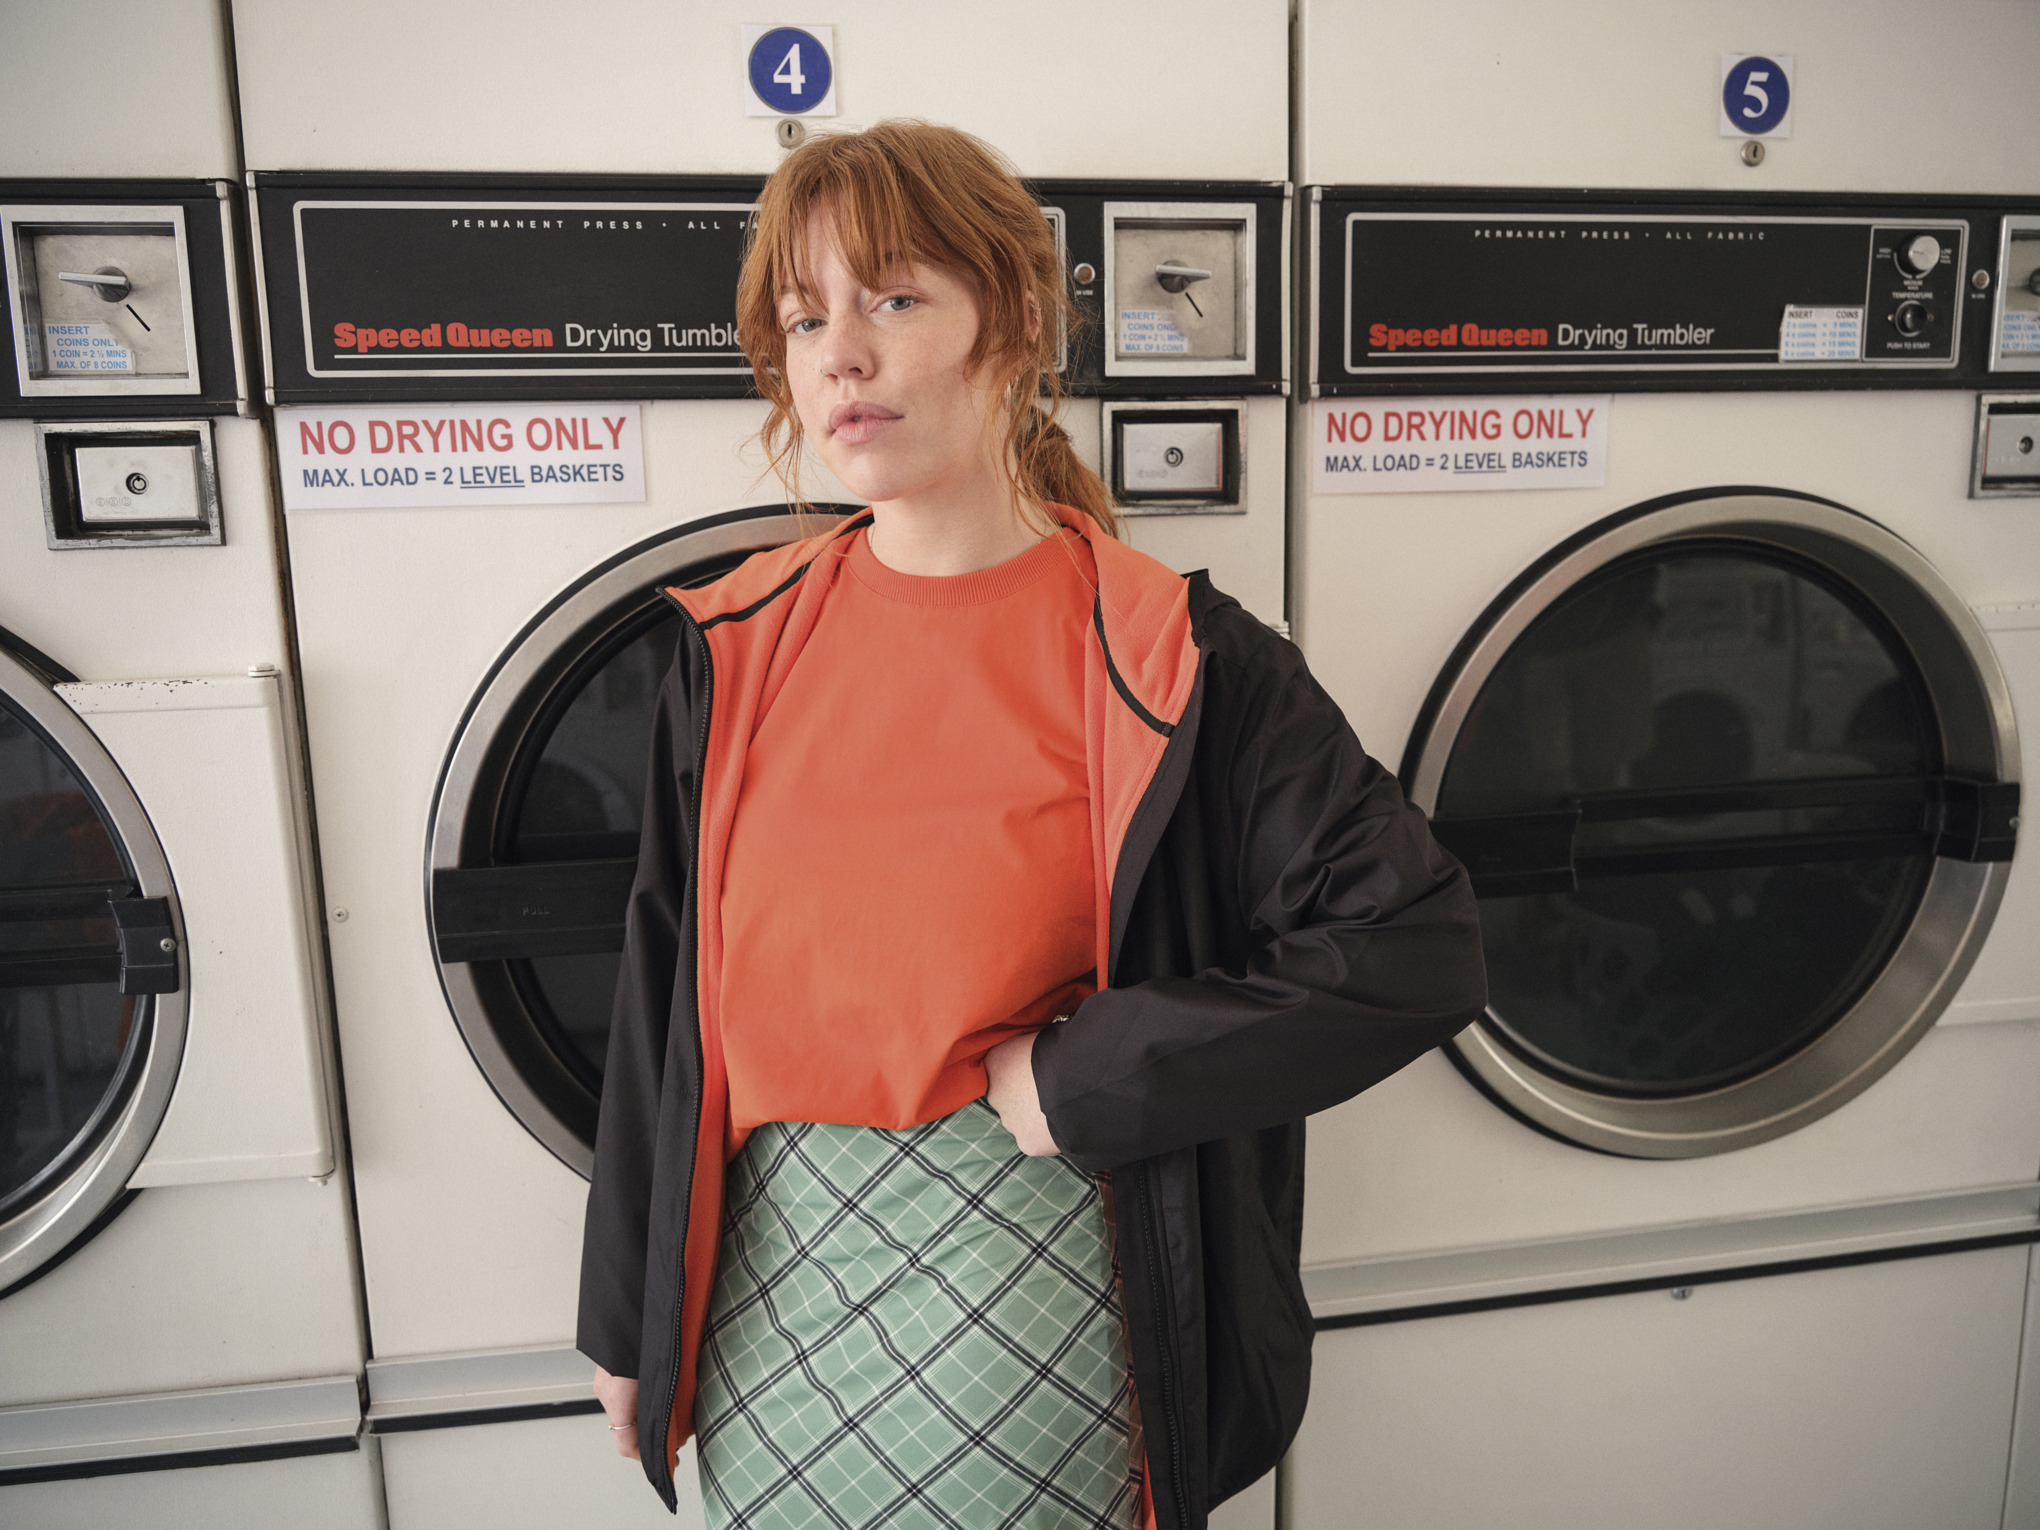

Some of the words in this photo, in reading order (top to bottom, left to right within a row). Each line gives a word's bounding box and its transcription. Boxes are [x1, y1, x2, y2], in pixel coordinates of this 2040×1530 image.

[773, 43, 806, 95] 4
[1742, 71, 1770, 118] 5
[452, 220, 563, 229] PERMANENT
[583, 220, 642, 230] PRESS
[688, 221, 720, 230] ALL
[1475, 230, 1567, 239] PERMANENT
[1581, 230, 1631, 240] PRESS
[1665, 231, 1693, 240] ALL
[1707, 231, 1765, 240] FABRIC
[1121, 312, 1156, 320] INSERT
[48, 326, 90, 335] INSERT
[1127, 323, 1154, 331] COINS
[1157, 323, 1174, 331] ONL
[334, 322, 442, 353] Speed
[446, 322, 553, 348] Queen
[565, 323, 652, 352] Drying
[657, 322, 741, 347] Tumble
[1167, 334, 1185, 342] MINS
[1368, 323, 1458, 351] Speed
[1461, 323, 1548, 347] Queen
[1557, 323, 1629, 350] Drying
[1633, 323, 1715, 346] Tumbler
[57, 338, 89, 347] COINS
[52, 350, 57, 358] 1
[59, 350, 80, 358] COIN
[90, 350, 95, 358] 2
[106, 350, 127, 358] MINS
[56, 361, 78, 369] MAX.
[80, 361, 91, 369] OF
[94, 361, 99, 369] 8
[101, 361, 127, 369] COINS
[1327, 411, 1372, 443] NO
[1384, 409, 1502, 441] DRYING
[1513, 408, 1595, 439] ONLY
[299, 420, 356, 455] NO
[368, 418, 514, 454] DRYING
[526, 416, 627, 451] ONLY
[1325, 455, 1367, 472] MAX.
[1373, 454, 1420, 472] LOAD
[1426, 457, 1435, 467] =
[1440, 454, 1448, 470] 2
[1453, 452, 1506, 472] LEVEL
[1512, 451, 1588, 468] BASKETS
[302, 468, 355, 488] MAX.
[361, 467, 419, 487] LOAD
[425, 471, 437, 481] =
[442, 467, 453, 485] 2
[460, 466, 525, 488] LEVEL
[530, 463, 625, 484] BASKETS
[522, 907, 550, 916] PULL
